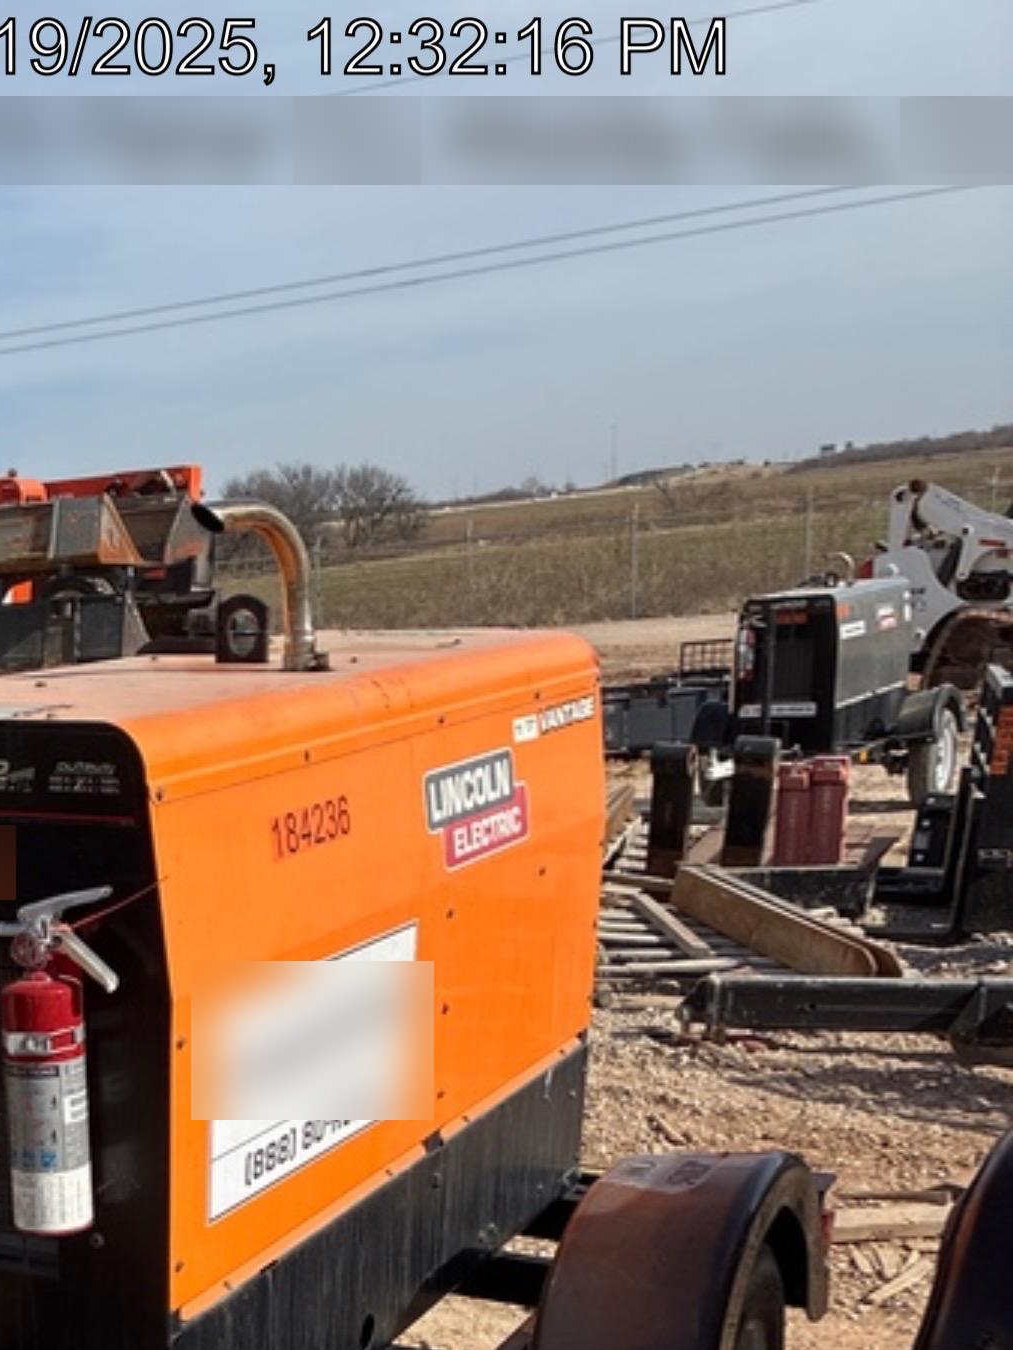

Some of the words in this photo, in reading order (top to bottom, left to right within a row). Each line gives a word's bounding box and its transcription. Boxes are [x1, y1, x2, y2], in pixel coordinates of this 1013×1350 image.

[428, 757, 511, 823] LINCOLN
[271, 793, 351, 859] 184236
[451, 805, 523, 859] ELECTRIC
[244, 1127, 297, 1186] (888)
